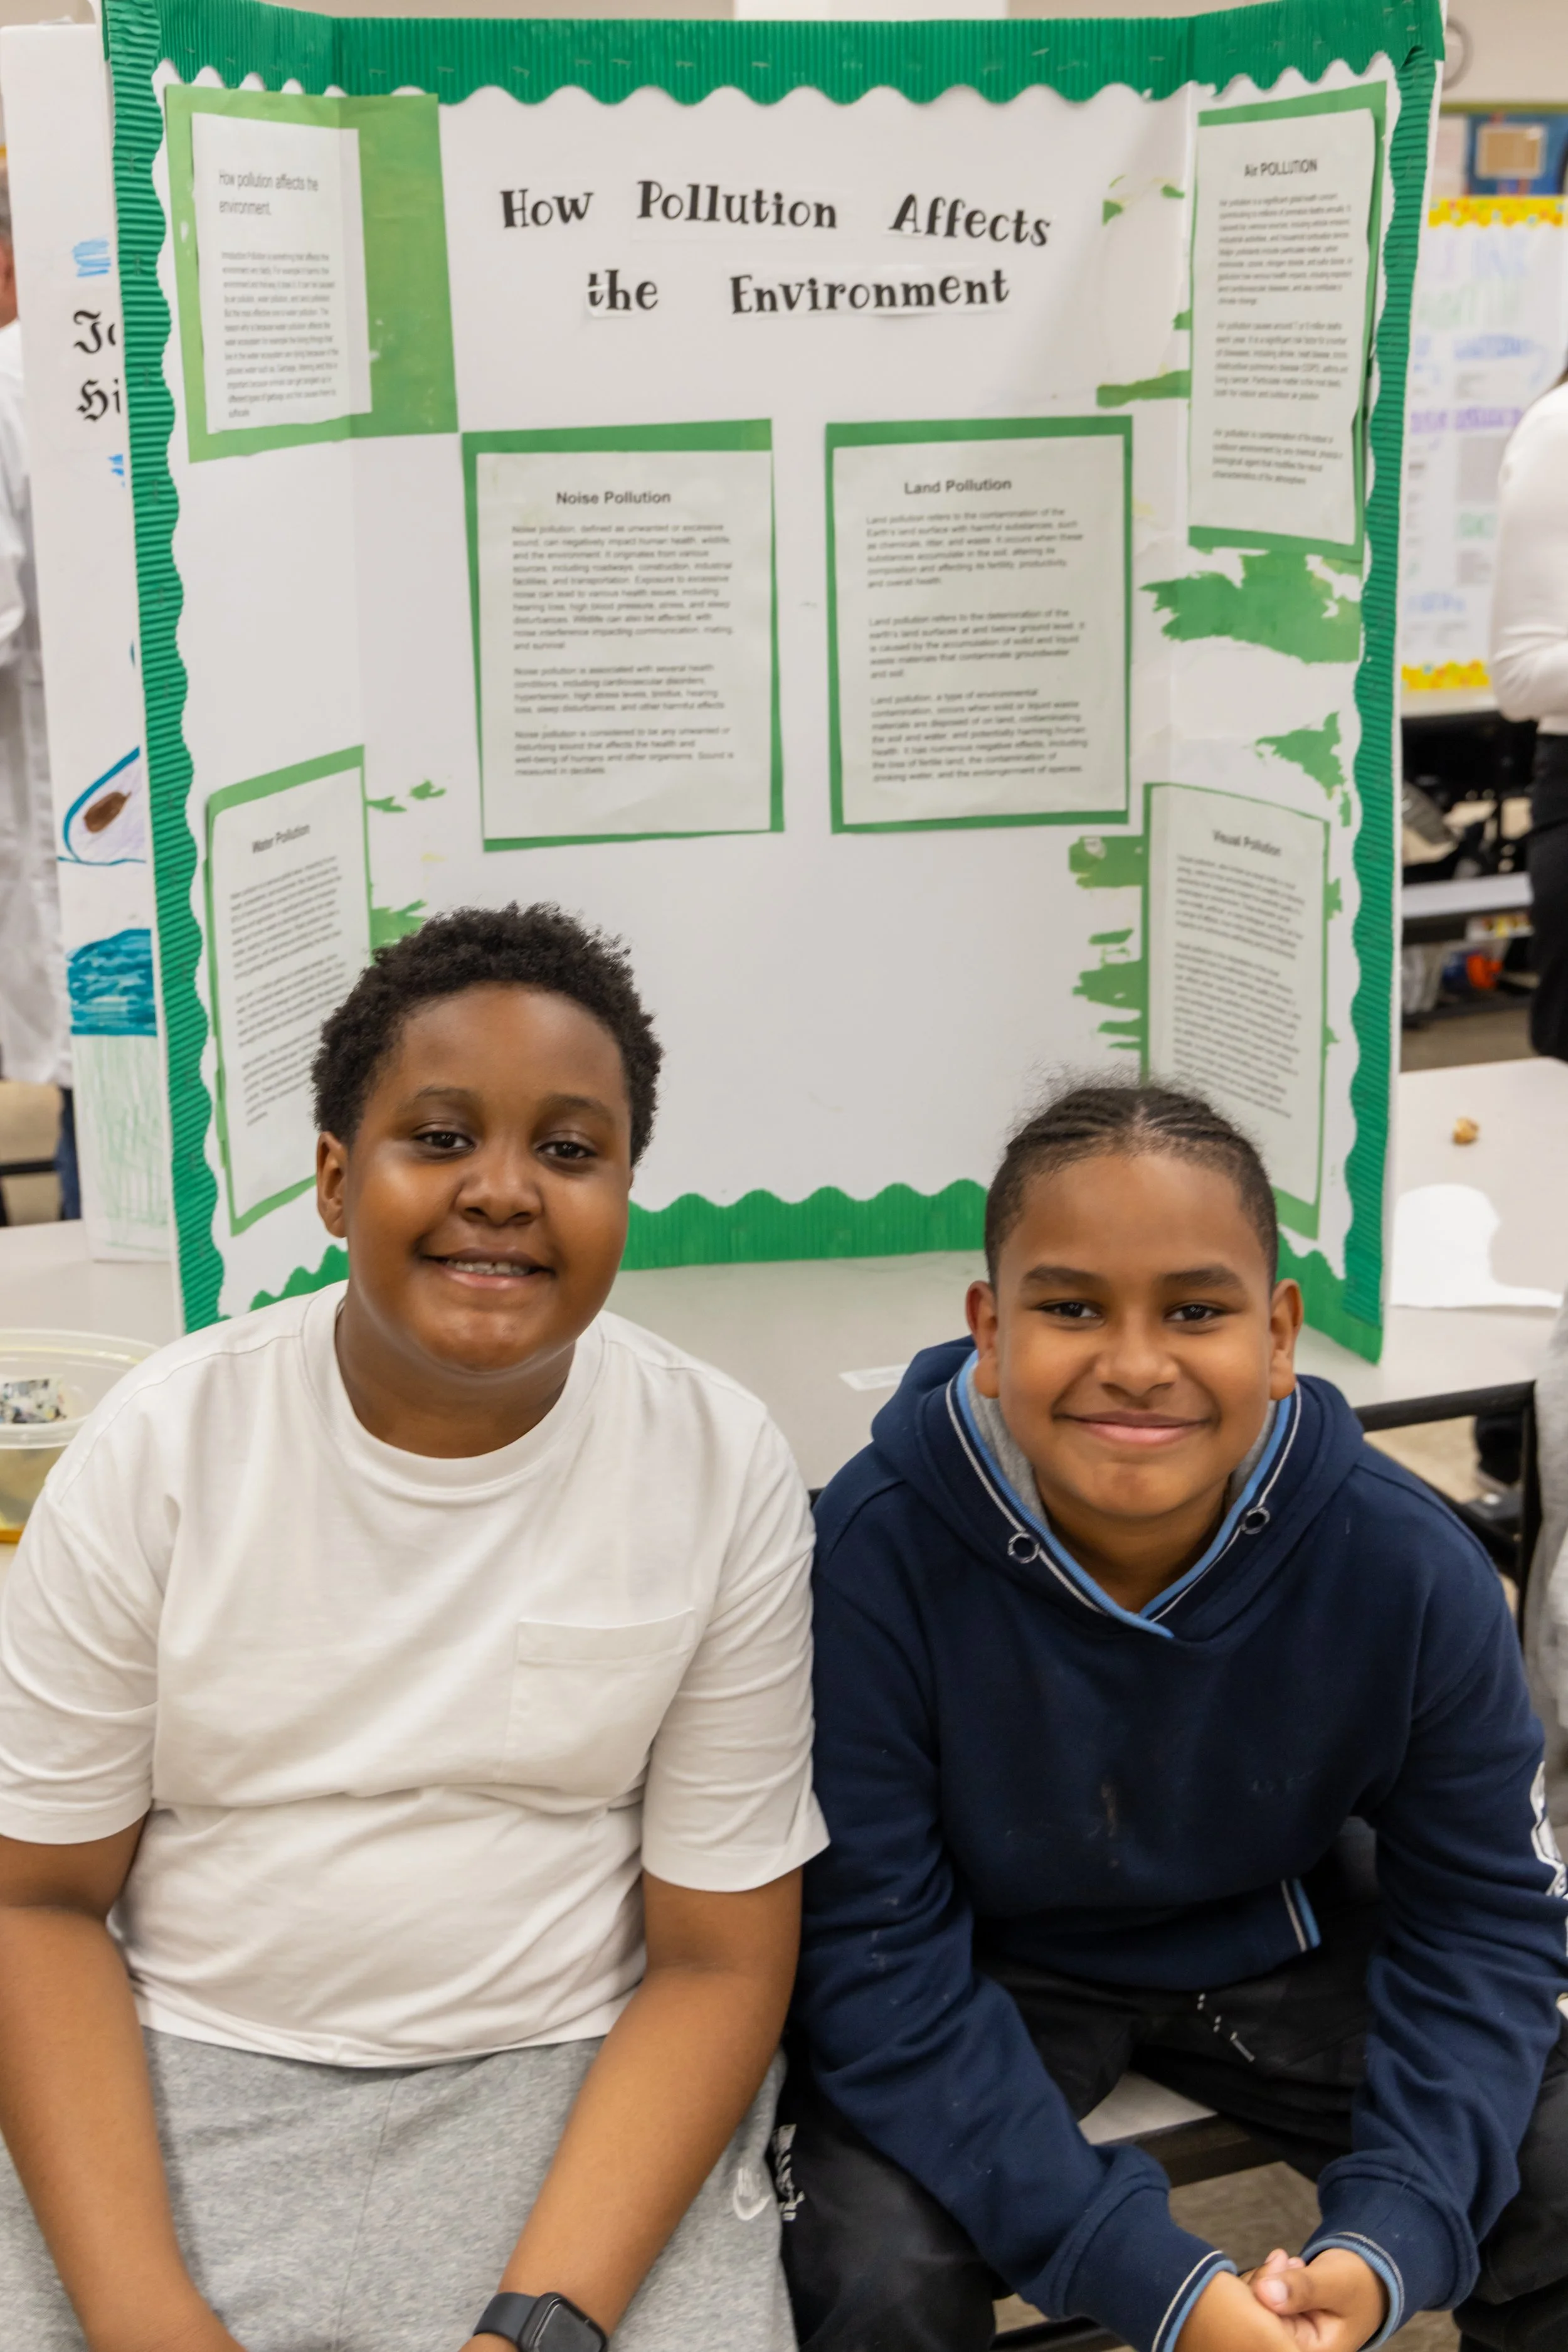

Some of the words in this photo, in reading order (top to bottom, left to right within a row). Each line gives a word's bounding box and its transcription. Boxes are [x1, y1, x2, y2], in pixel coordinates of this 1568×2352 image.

[1244, 164, 1258, 177] Air
[1260, 158, 1318, 176] POLLUTION
[219, 170, 235, 186] How
[501, 189, 595, 229] How
[637, 181, 837, 230] Pollution
[889, 194, 1051, 247] Affects
[588, 270, 659, 312] the
[730, 270, 1010, 315] Environment
[904, 481, 942, 496] Land
[946, 479, 1013, 493] Pollution
[556, 492, 600, 506] Noise
[604, 491, 672, 505] Pollution
